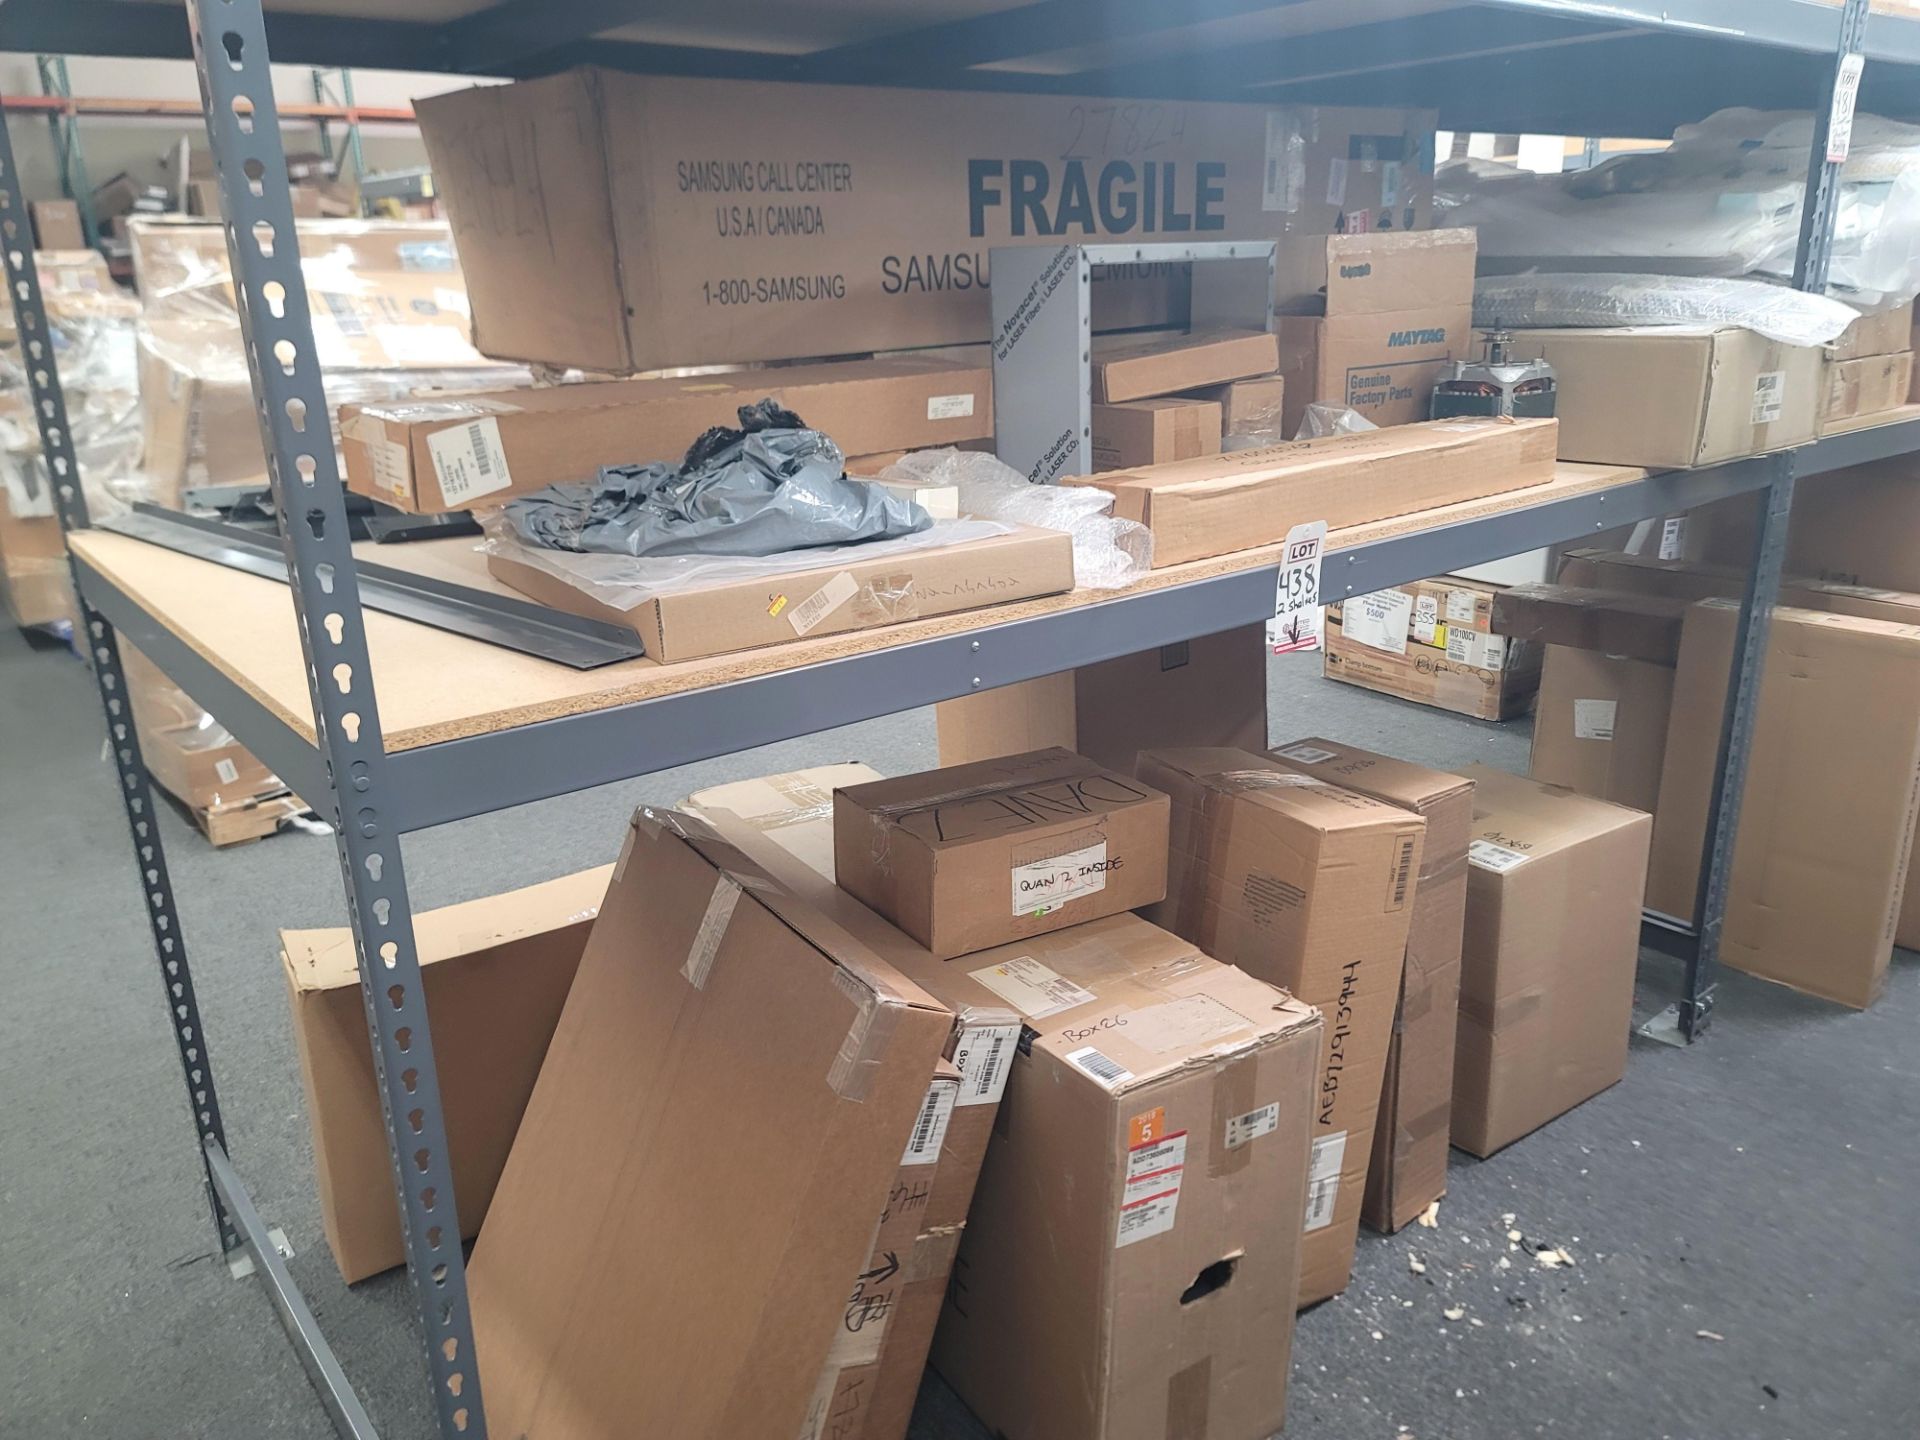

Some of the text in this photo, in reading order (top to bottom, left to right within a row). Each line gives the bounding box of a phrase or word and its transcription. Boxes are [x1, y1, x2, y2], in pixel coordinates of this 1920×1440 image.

[678, 161, 853, 192] SAMSUNG CALL CENTER
[968, 159, 1227, 238] FRAGILE
[716, 206, 756, 237] U.S.A
[766, 206, 825, 236] CANADA
[881, 253, 992, 294] SAMSU
[1040, 245, 1071, 284] Solution
[702, 274, 846, 306] 1-800-SAMSUNG
[1006, 322, 1028, 350] LASER
[1043, 270, 1066, 299] LASER
[1387, 327, 1446, 348] MAYTAG
[1350, 373, 1392, 390] Genuine
[1350, 385, 1413, 407] Factory Parts
[1043, 428, 1073, 464] Solution
[1047, 451, 1070, 478] LASER
[1291, 542, 1316, 560] LOT
[1278, 562, 1316, 599] 438
[1276, 602, 1286, 616] 2
[1366, 607, 1385, 619] $500
[1020, 856, 1124, 892] QUAN 2 INSIDE
[1318, 959, 1362, 1126] AEB72913944
[1141, 1123, 1152, 1142] 5
